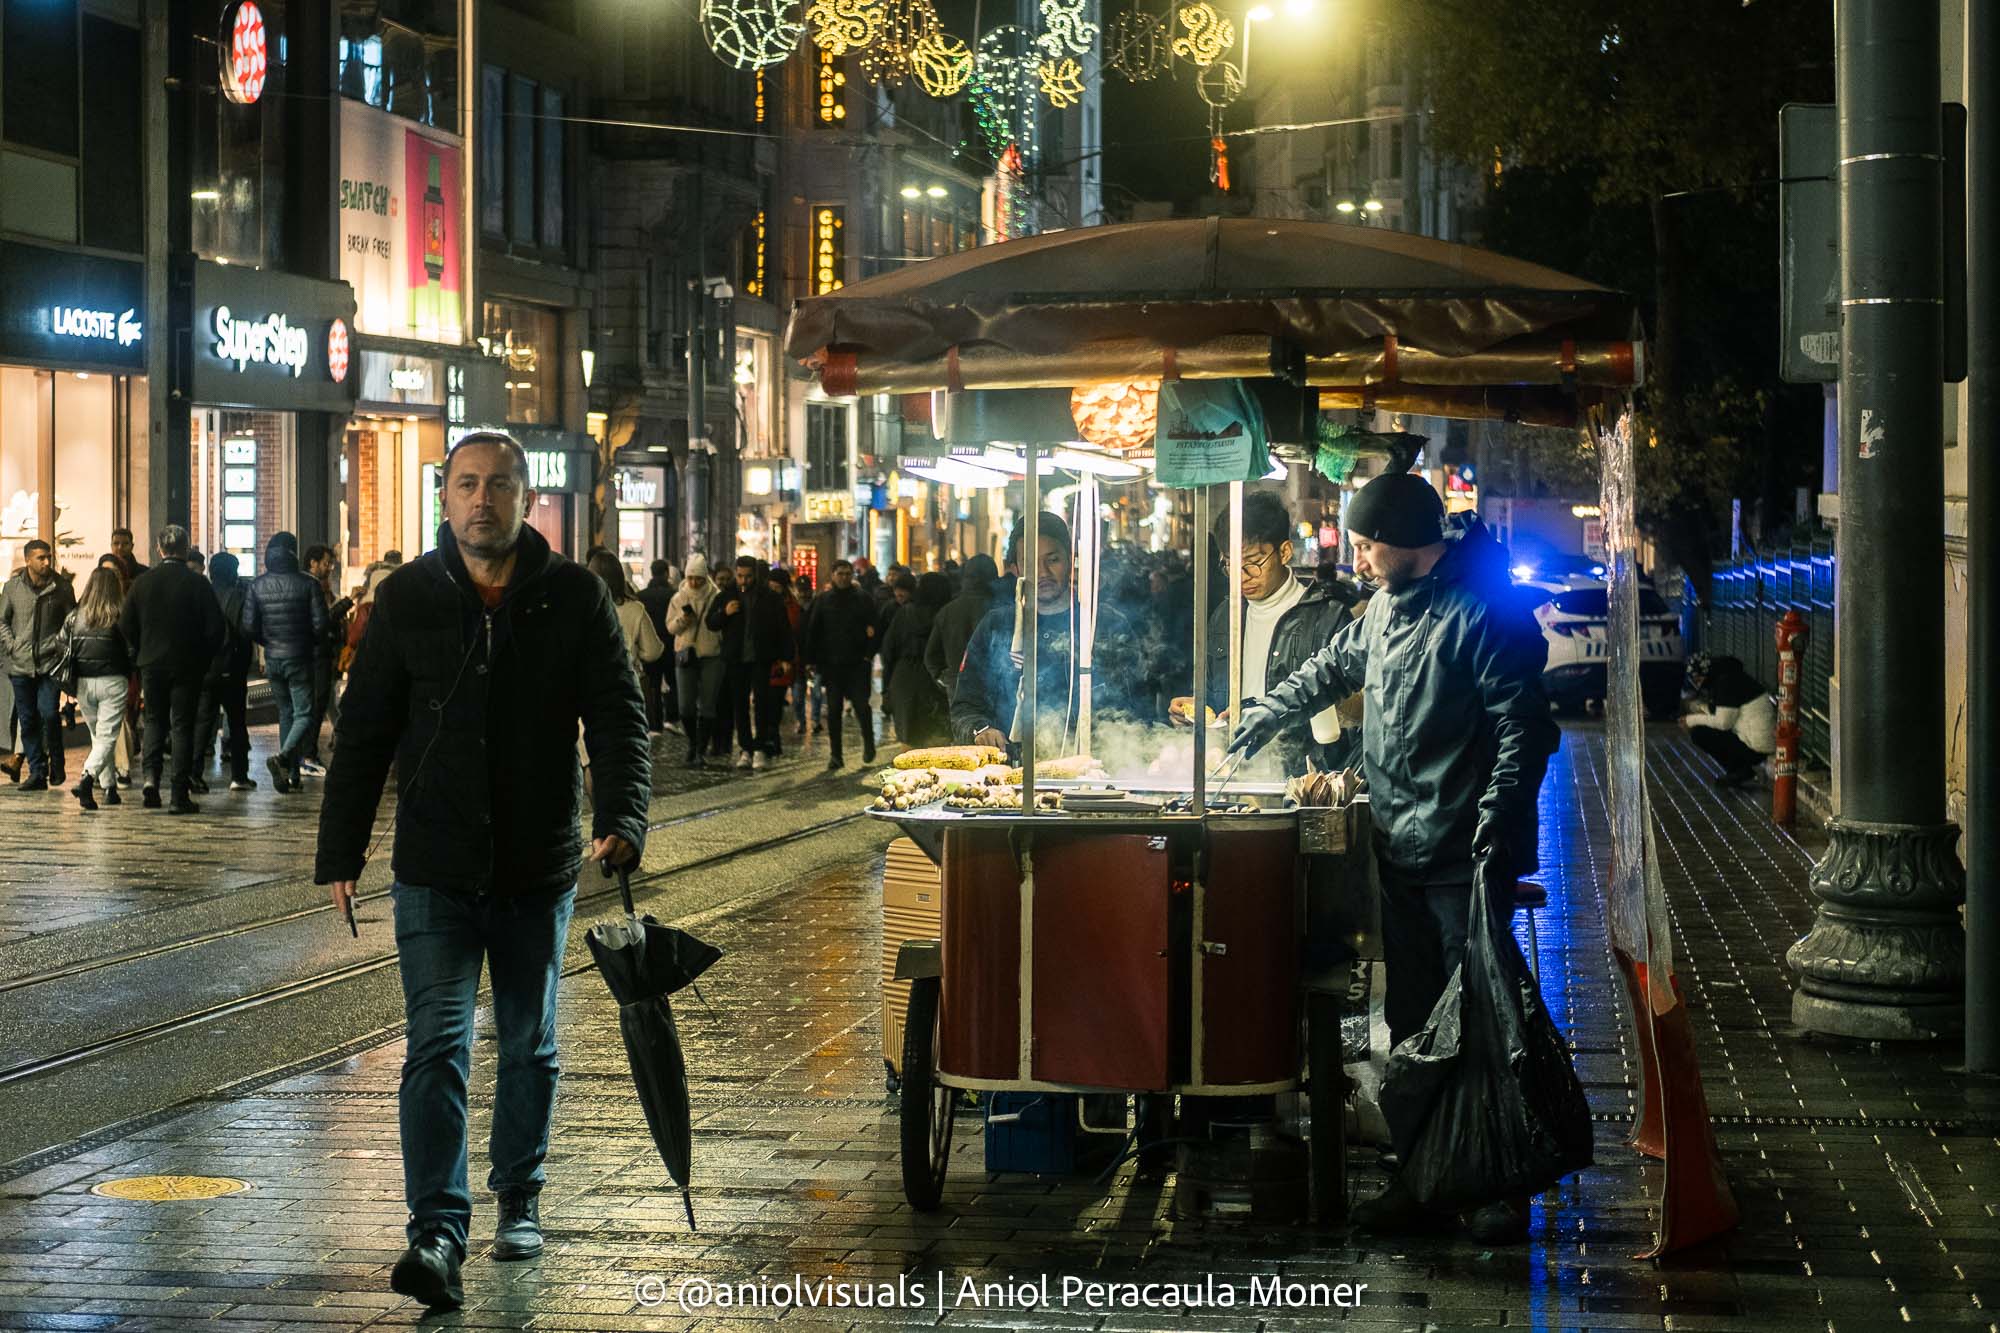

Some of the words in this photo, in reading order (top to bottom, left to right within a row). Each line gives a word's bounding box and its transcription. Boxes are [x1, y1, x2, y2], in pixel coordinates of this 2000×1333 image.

[340, 180, 388, 216] SWATCH
[347, 234, 369, 256] BREAK
[54, 306, 115, 340] LACOSTE
[216, 305, 308, 378] SuperStep
[524, 451, 567, 488] UESS
